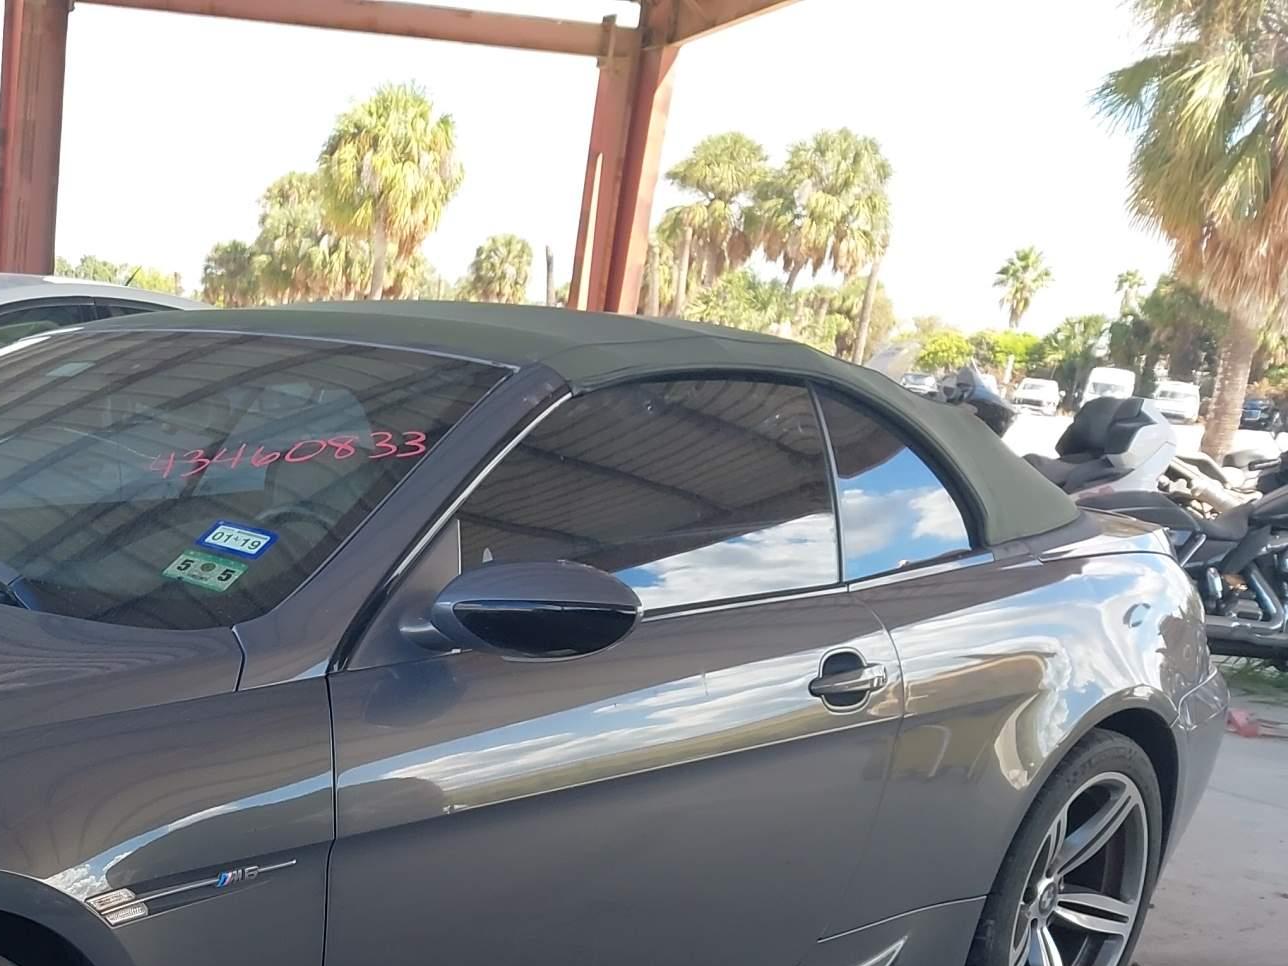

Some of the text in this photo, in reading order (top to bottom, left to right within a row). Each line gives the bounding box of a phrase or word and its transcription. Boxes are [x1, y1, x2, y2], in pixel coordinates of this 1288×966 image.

[149, 431, 427, 480] 43460833
[211, 531, 234, 544] 01
[239, 537, 262, 550] 19
[176, 559, 194, 572] 5
[217, 568, 236, 582] 5
